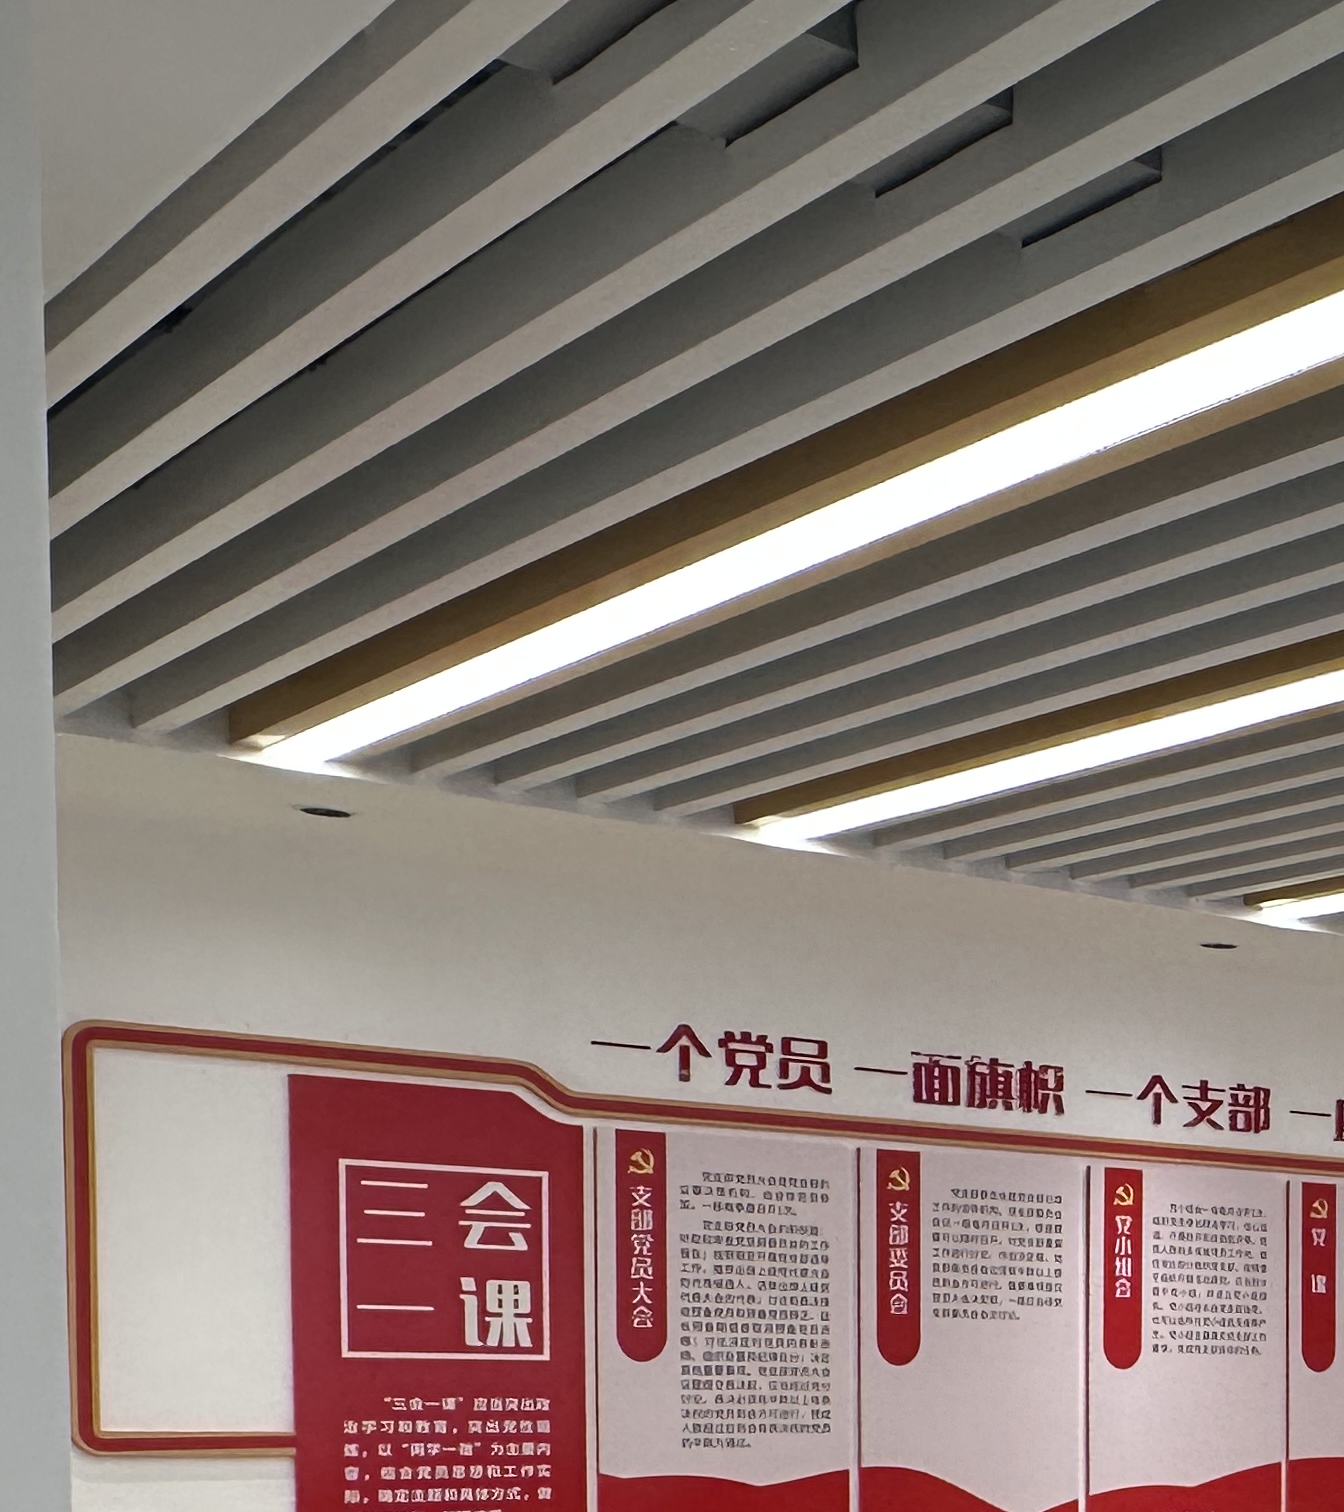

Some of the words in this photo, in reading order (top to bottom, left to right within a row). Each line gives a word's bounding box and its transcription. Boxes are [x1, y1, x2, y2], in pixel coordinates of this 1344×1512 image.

[590, 1023, 833, 1095] 一个党员
[854, 1050, 1066, 1116] 一面旗帜
[1085, 1074, 1271, 1134] 一个支部
[356, 1181, 532, 1252] 三会
[356, 1276, 532, 1349] 一课
